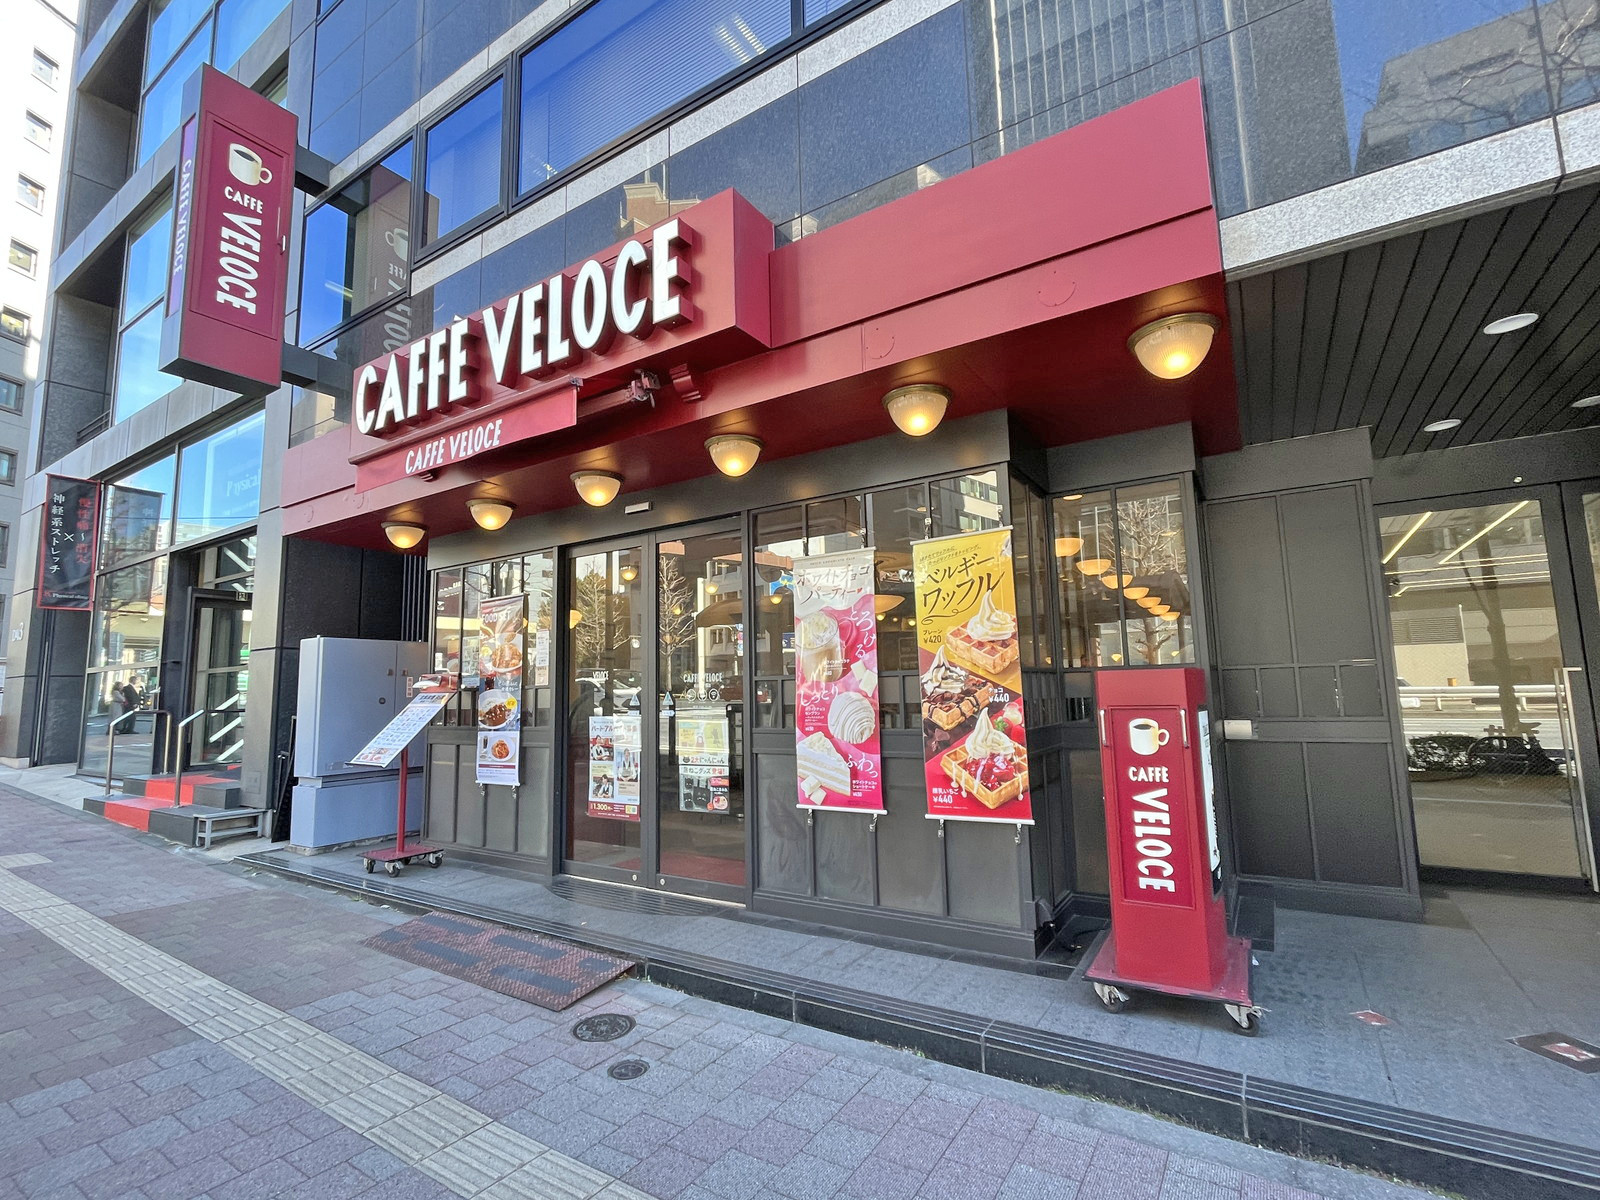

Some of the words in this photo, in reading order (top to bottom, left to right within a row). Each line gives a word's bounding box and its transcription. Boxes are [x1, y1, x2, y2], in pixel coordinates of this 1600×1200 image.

[216, 212, 262, 315] VELOCE
[482, 217, 682, 385] VELOCE
[449, 418, 503, 460] VELOCE
[49, 493, 66, 574] 神経系ストレッチ
[796, 564, 871, 587] ホワイトチョコ
[926, 552, 995, 584] ベルギー
[922, 571, 1006, 615] ワッフル
[850, 605, 877, 658] とろける
[924, 635, 942, 644] ¥420
[800, 682, 839, 706] しっとり
[988, 693, 1010, 703] ¥440
[933, 795, 953, 804] ¥440
[1132, 788, 1176, 893] VELOCE
